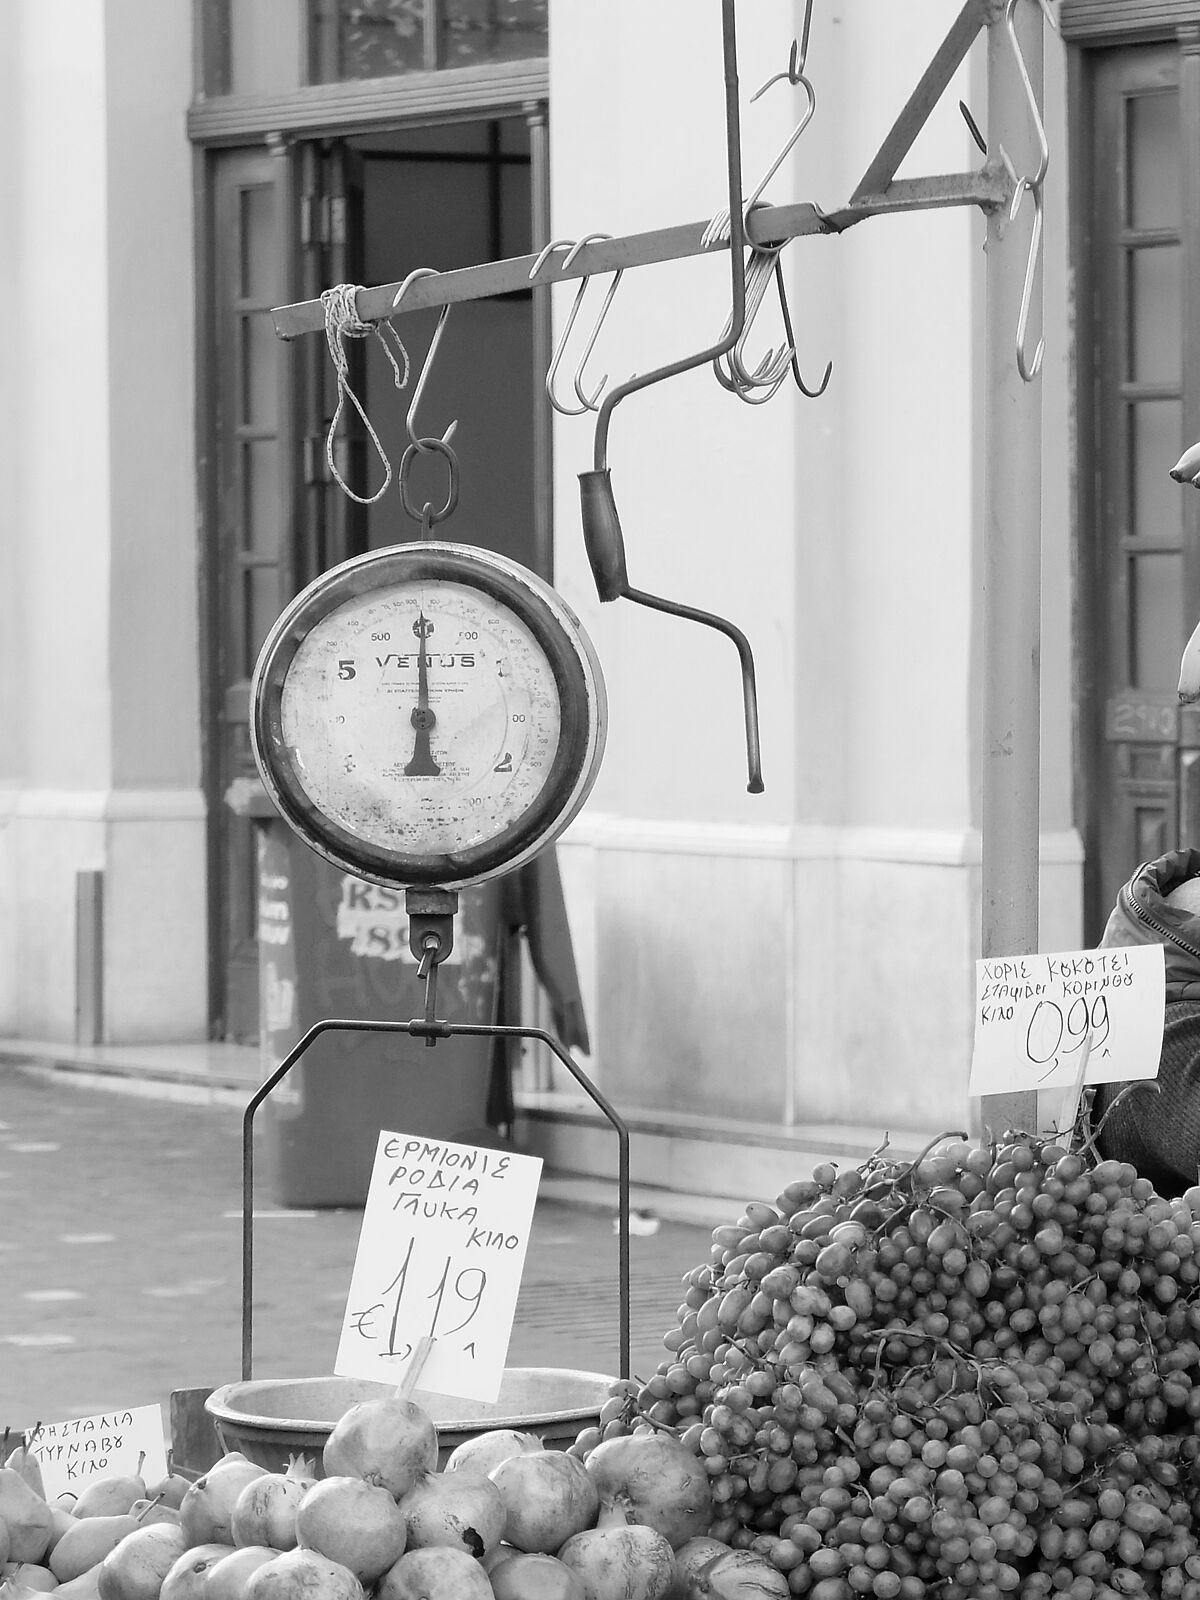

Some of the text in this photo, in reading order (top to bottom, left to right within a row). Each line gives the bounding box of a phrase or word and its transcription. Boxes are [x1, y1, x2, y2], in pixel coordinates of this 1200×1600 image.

[371, 632, 391, 642] 500
[338, 660, 356, 680] 5
[376, 653, 476, 669] VENUS
[388, 1165, 479, 1197] ΡΟΔΙΑ
[392, 1191, 478, 1225] ΓΛΥΚΑ
[465, 1226, 520, 1251] ΚΙΛΟ
